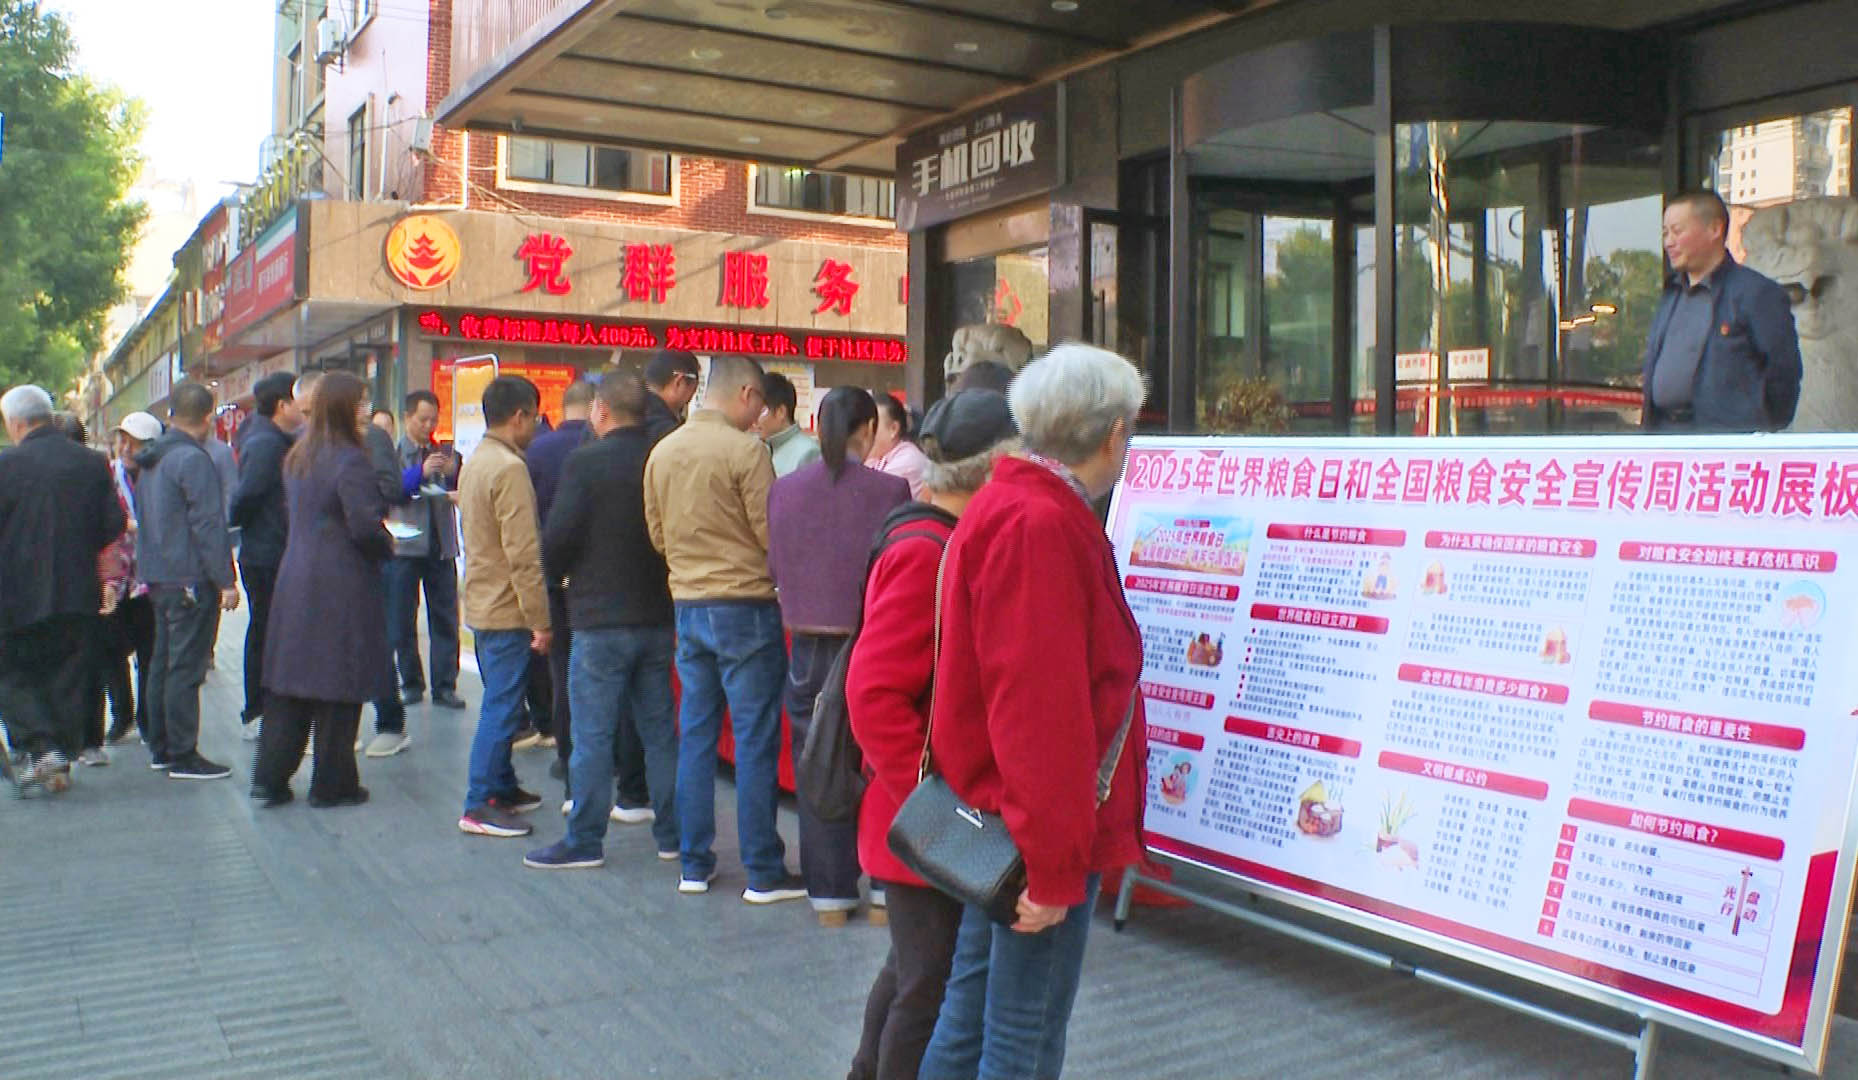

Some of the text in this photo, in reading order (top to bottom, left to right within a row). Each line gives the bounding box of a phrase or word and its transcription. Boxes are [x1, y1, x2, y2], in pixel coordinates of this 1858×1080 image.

[911, 120, 1037, 197] 手机回收
[518, 231, 909, 316] 党群服务
[1132, 455, 1858, 517] 2025年世界粮食日和全国粮食安全宣传周活动展板
[1303, 526, 1367, 544] 什么是节约粮食
[1439, 533, 1584, 556] 为什么要确保国家的粮食安全
[1638, 545, 1820, 570] 对粮食安全始终要有危机意识
[1642, 711, 1752, 741] 节约粮食的重要性
[1422, 762, 1488, 787] 文明餐桌公约
[1630, 812, 1719, 843] 如何节约粮食？
